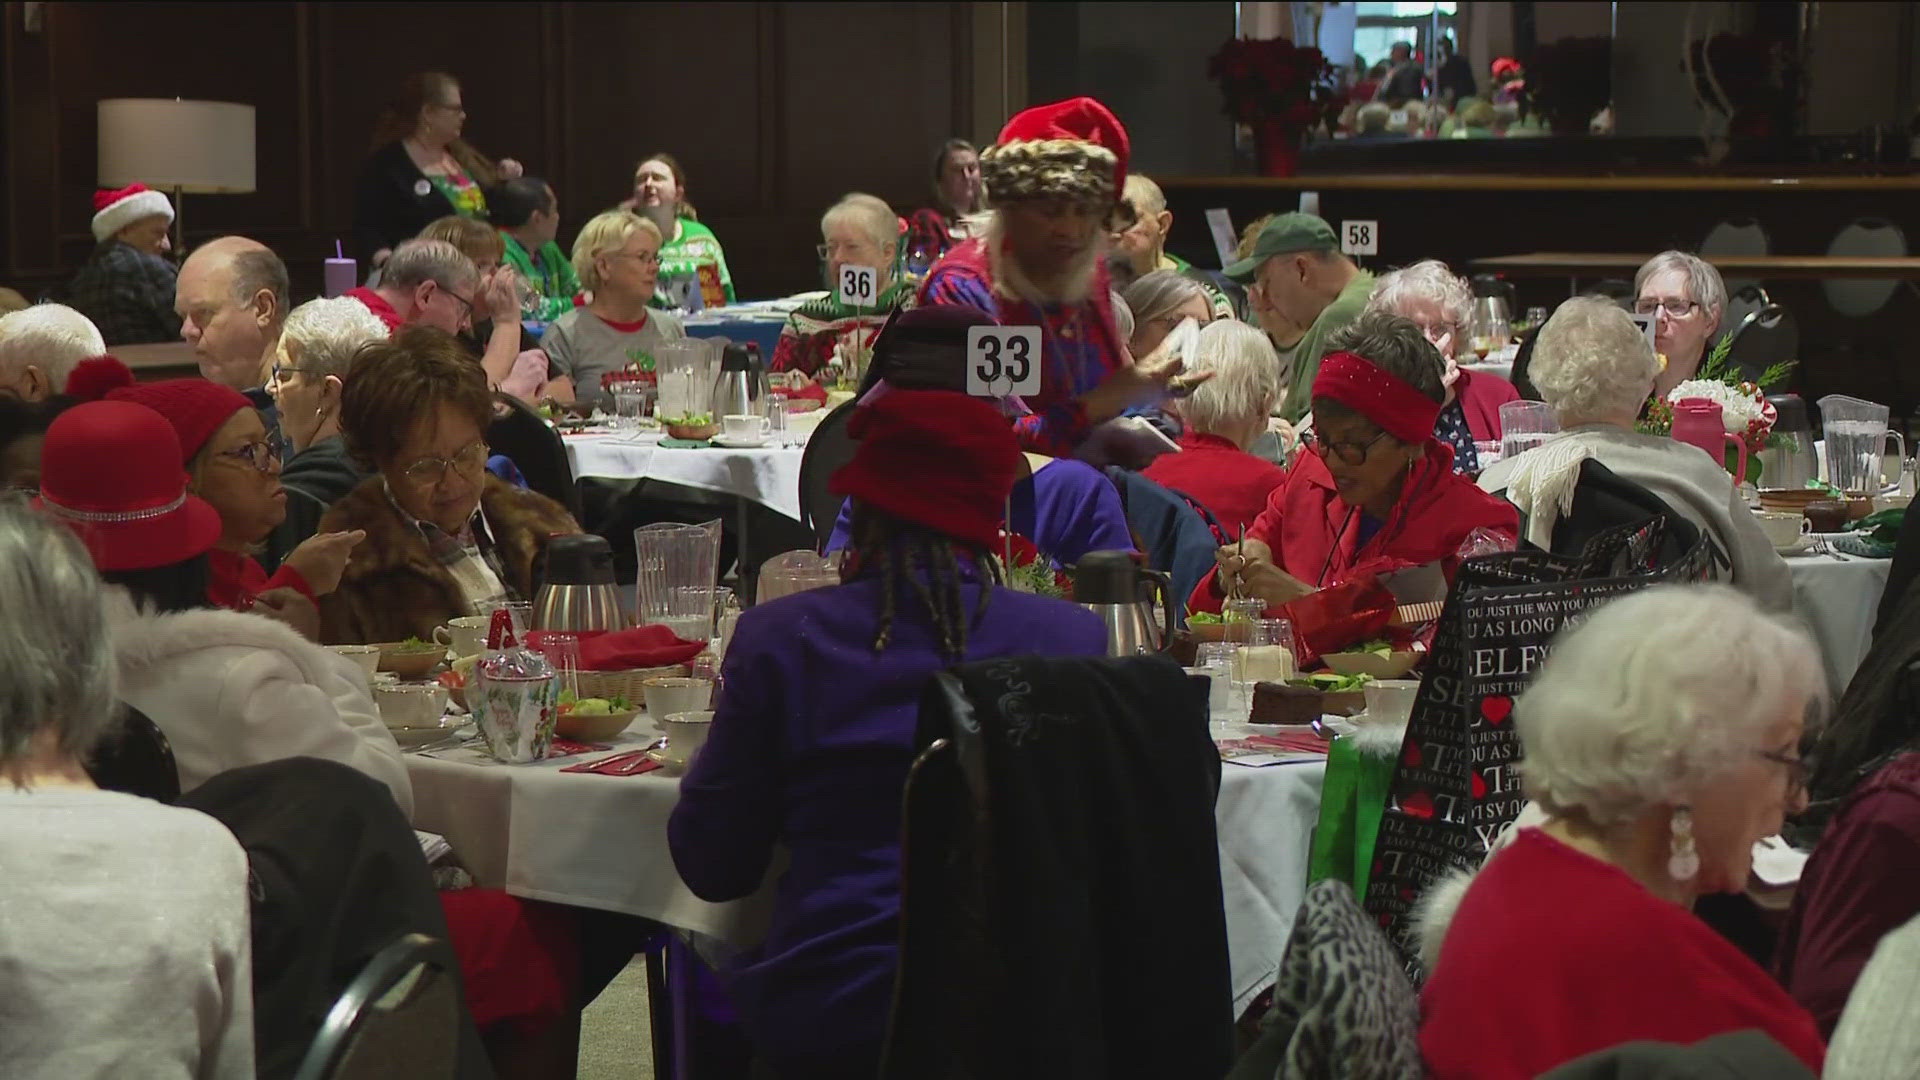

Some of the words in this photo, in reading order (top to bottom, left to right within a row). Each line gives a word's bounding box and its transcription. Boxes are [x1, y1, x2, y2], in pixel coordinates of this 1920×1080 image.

[1349, 225, 1370, 246] 58
[844, 270, 870, 298] 36
[976, 335, 1030, 383] 33
[1485, 605, 1511, 618] JUST
[1513, 603, 1534, 616] THE
[1536, 600, 1560, 614] WAY
[1562, 598, 1584, 611] YOU
[1483, 621, 1505, 638] AS
[1511, 617, 1555, 636] LONG
[1469, 646, 1538, 678] ELF
[1478, 682, 1504, 695] JUST
[1480, 731, 1506, 743] JUST
[1490, 743, 1511, 760] AS
